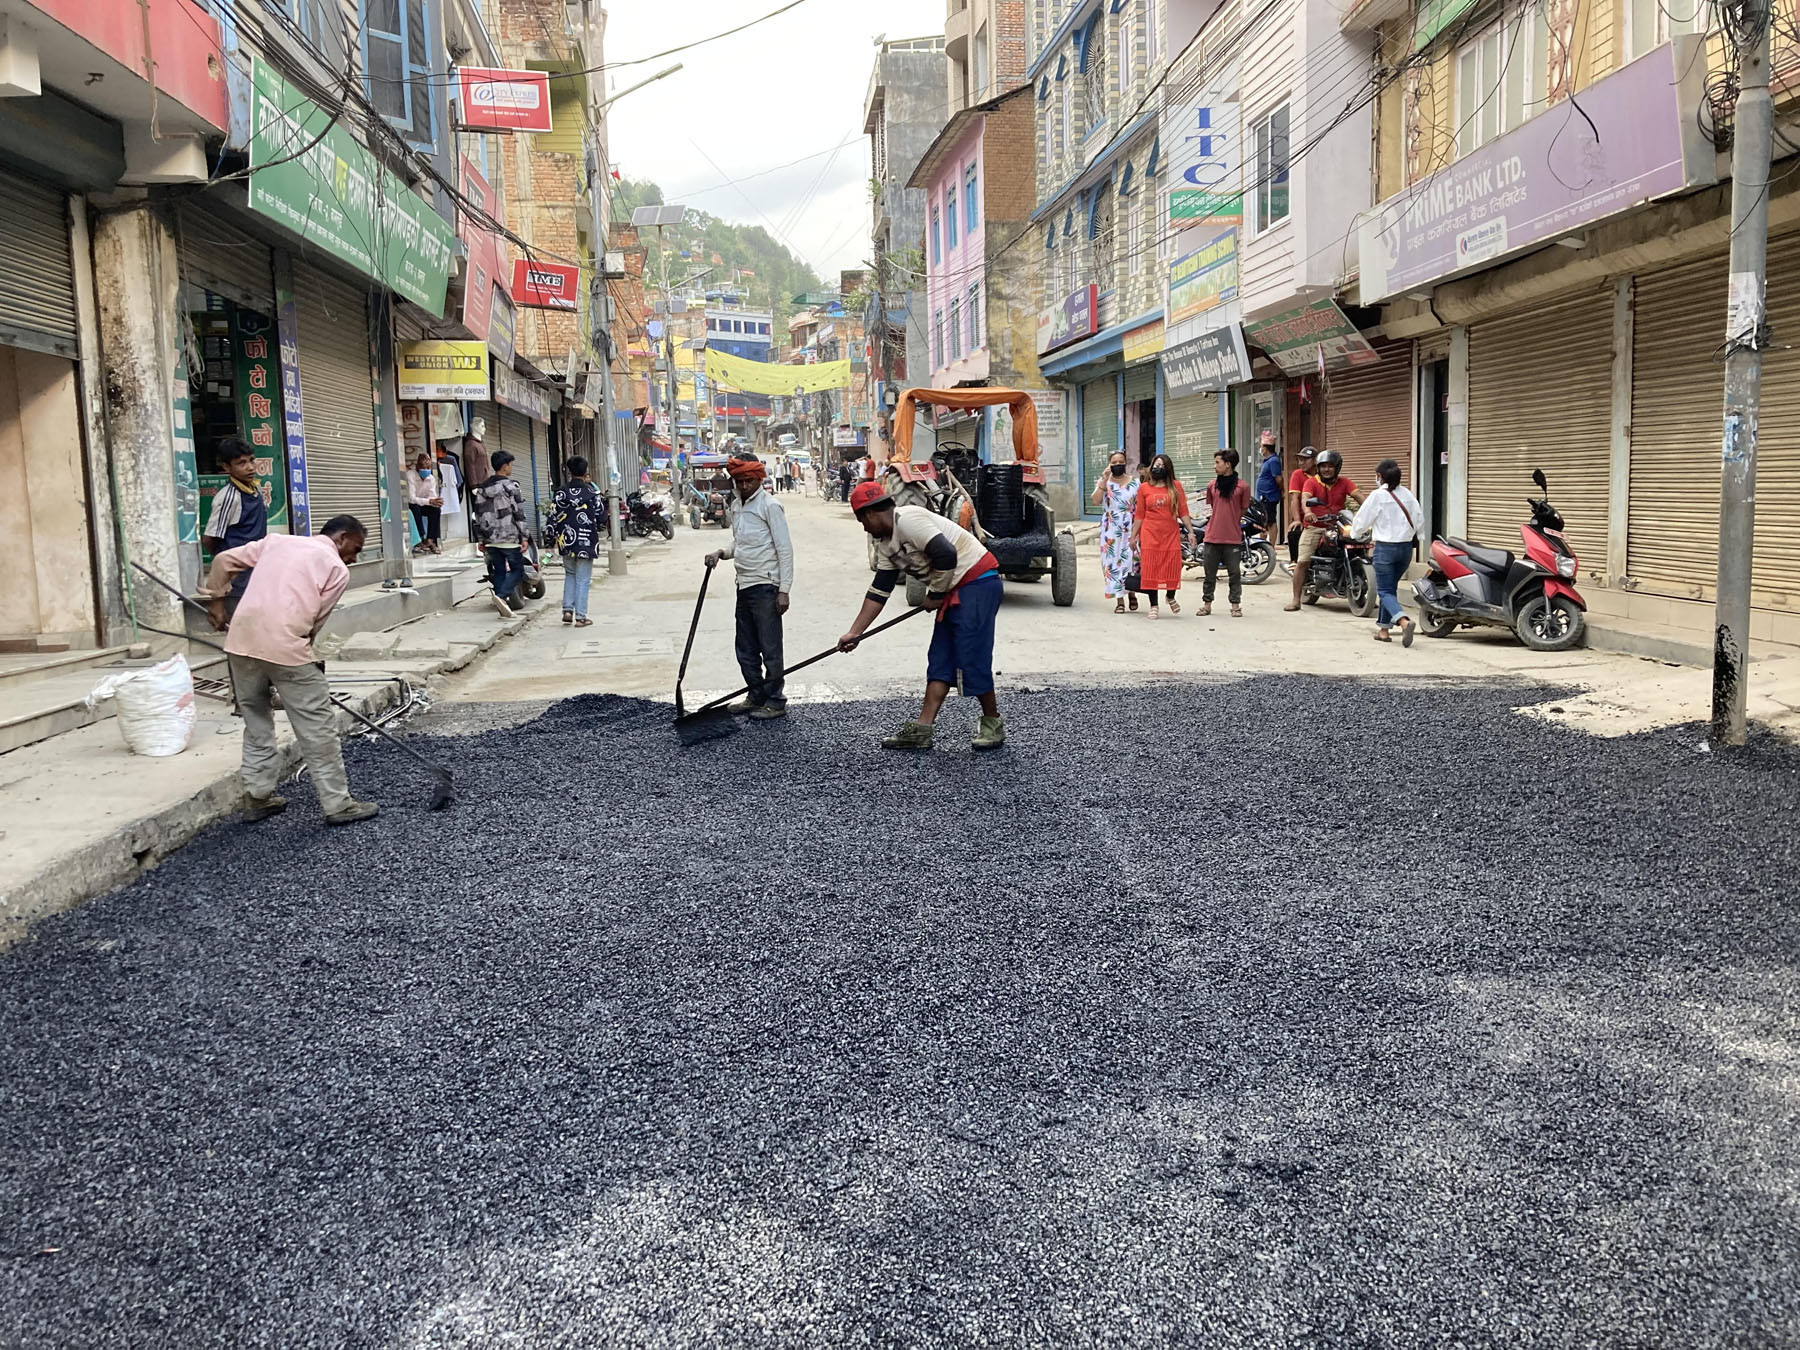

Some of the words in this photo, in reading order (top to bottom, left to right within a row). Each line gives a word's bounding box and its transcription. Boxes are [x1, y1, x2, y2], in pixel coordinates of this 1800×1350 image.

[1456, 169, 1493, 208] BANK
[1496, 156, 1526, 189] LTD.
[533, 274, 561, 287] IME
[1217, 345, 1239, 374] Studio
